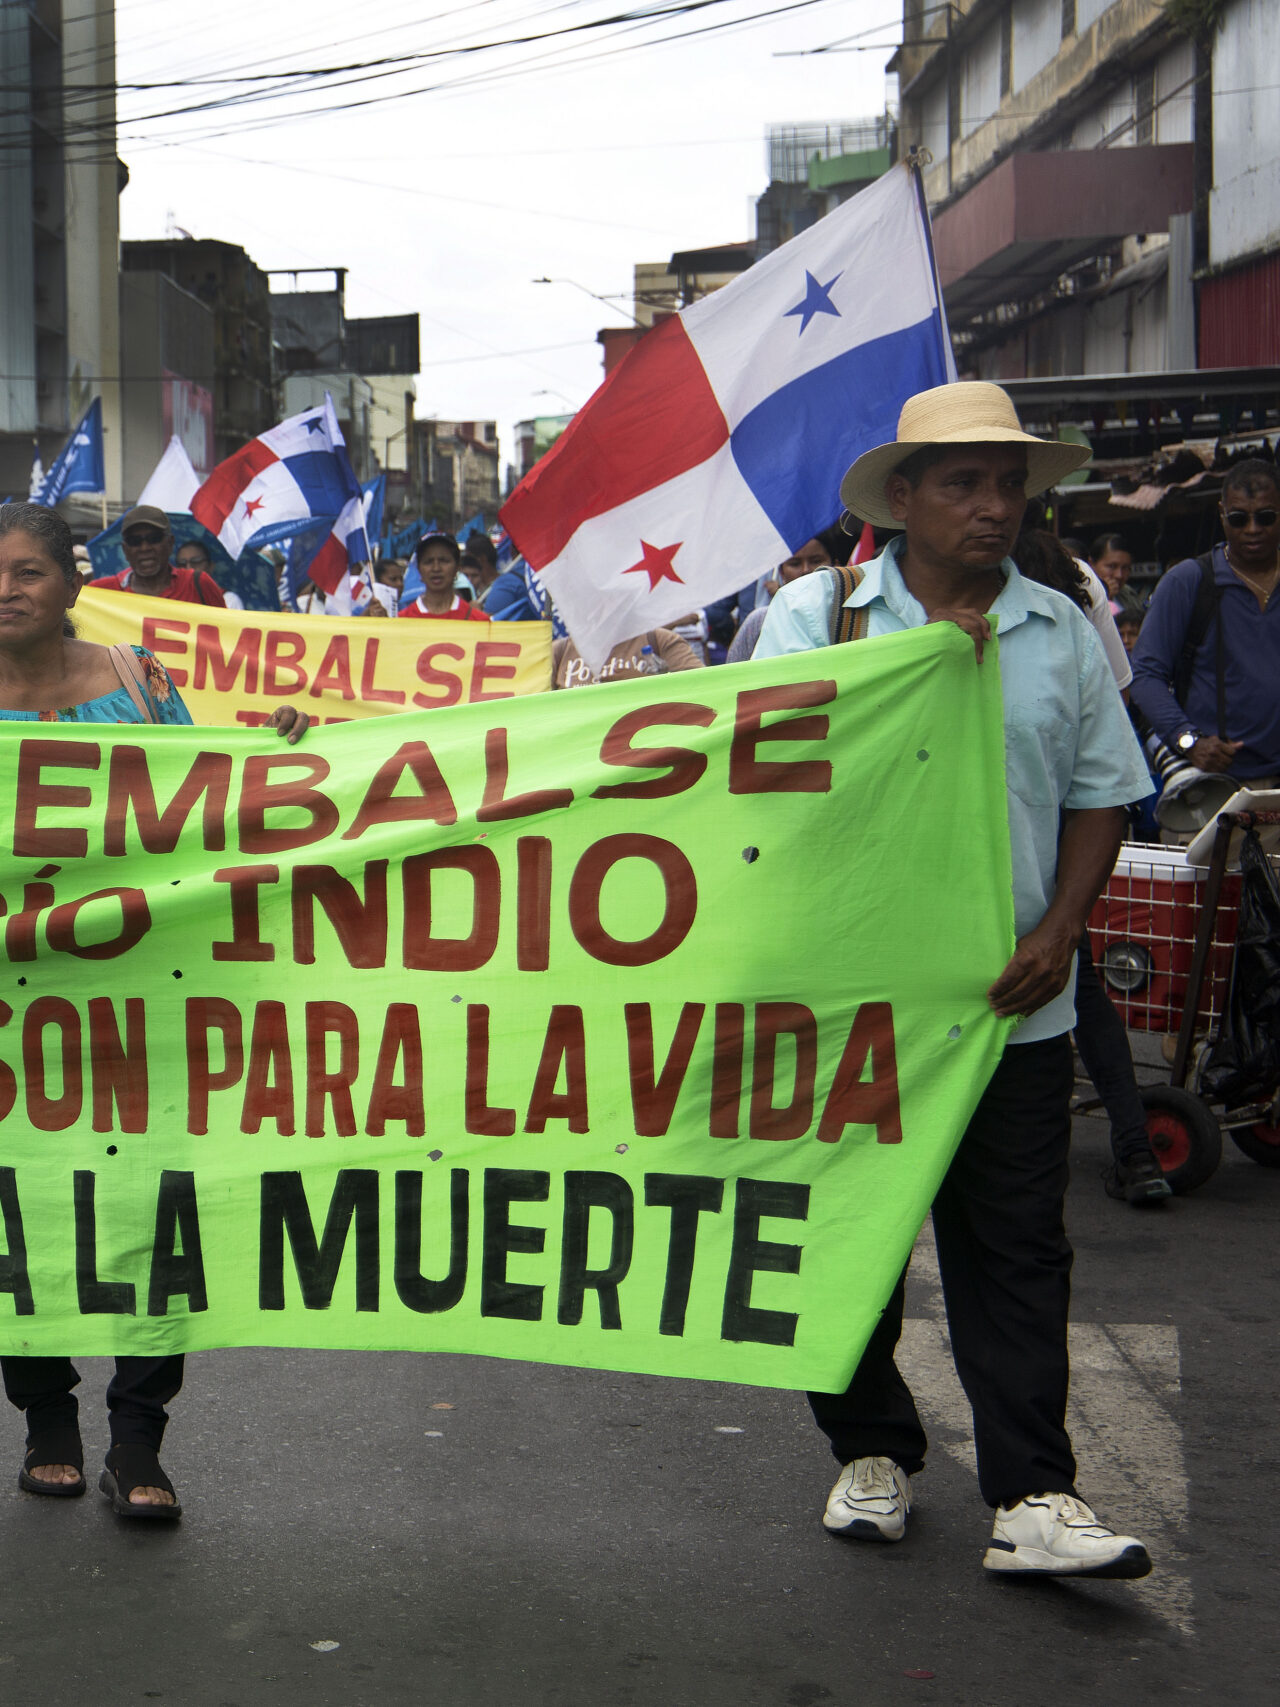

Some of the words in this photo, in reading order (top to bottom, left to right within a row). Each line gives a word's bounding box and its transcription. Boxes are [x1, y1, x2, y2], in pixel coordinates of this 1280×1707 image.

[142, 616, 522, 709] EMBALSE
[13, 679, 838, 858] EMBALSE
[211, 832, 698, 973] INDIO
[185, 996, 426, 1138] PARA
[465, 1003, 590, 1137] LA
[624, 1001, 903, 1144] VIDA
[73, 1169, 209, 1317] LA
[258, 1167, 811, 1347] MUERTE
